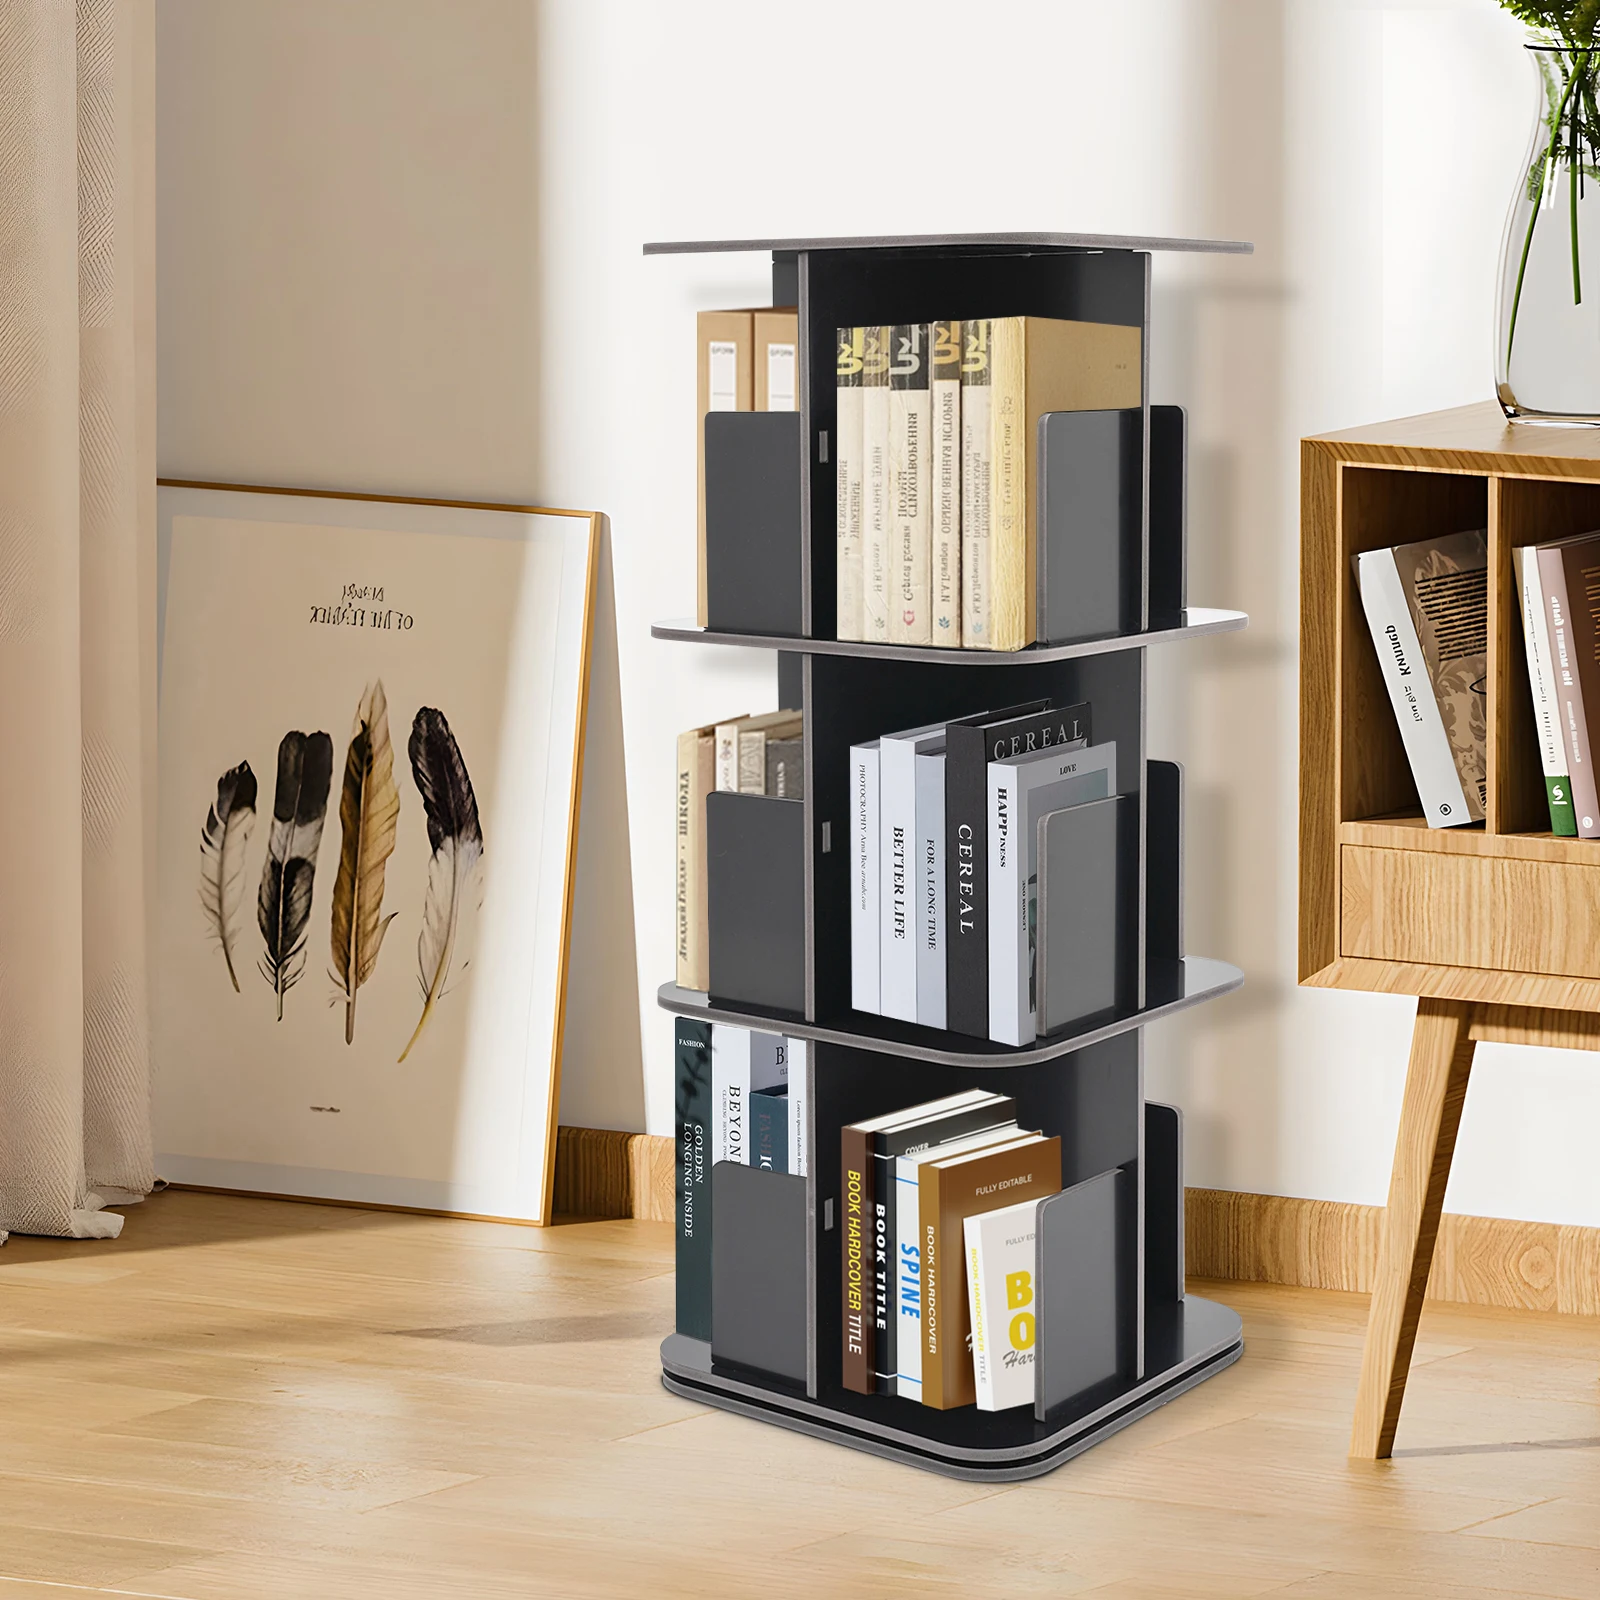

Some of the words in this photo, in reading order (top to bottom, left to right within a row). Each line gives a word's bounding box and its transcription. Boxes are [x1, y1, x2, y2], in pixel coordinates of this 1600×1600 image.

[994, 720, 1083, 759] CEREAL
[1059, 764, 1077, 776] LOVE
[893, 826, 904, 897] BETTER
[926, 838, 935, 865] FOR
[926, 868, 935, 877] A
[957, 823, 974, 935] CEREAL
[927, 879, 936, 917] LONG
[893, 900, 905, 939] LIFE
[928, 918, 937, 950] TIME
[678, 1038, 706, 1049] FASHION
[684, 1122, 693, 1187] LONGING
[694, 1124, 704, 1184] GOLDEN
[905, 1142, 929, 1155] COVER
[848, 1170, 861, 1215] BOOK
[975, 1184, 998, 1196] FULLY
[999, 1174, 1032, 1191] EDITABLE
[684, 1190, 693, 1238] INSIDE
[876, 1203, 886, 1264] BOOK
[927, 1225, 935, 1265] BOOK
[1005, 1235, 1026, 1246] FULLY
[848, 1217, 862, 1310] HARDCOVER
[901, 1243, 920, 1319] SPINE
[971, 1247, 979, 1283] BOOK
[876, 1272, 886, 1330] TITLE
[927, 1267, 936, 1354] HARDCOVER
[848, 1315, 862, 1354] TITLE
[1002, 1350, 1036, 1370] Har
